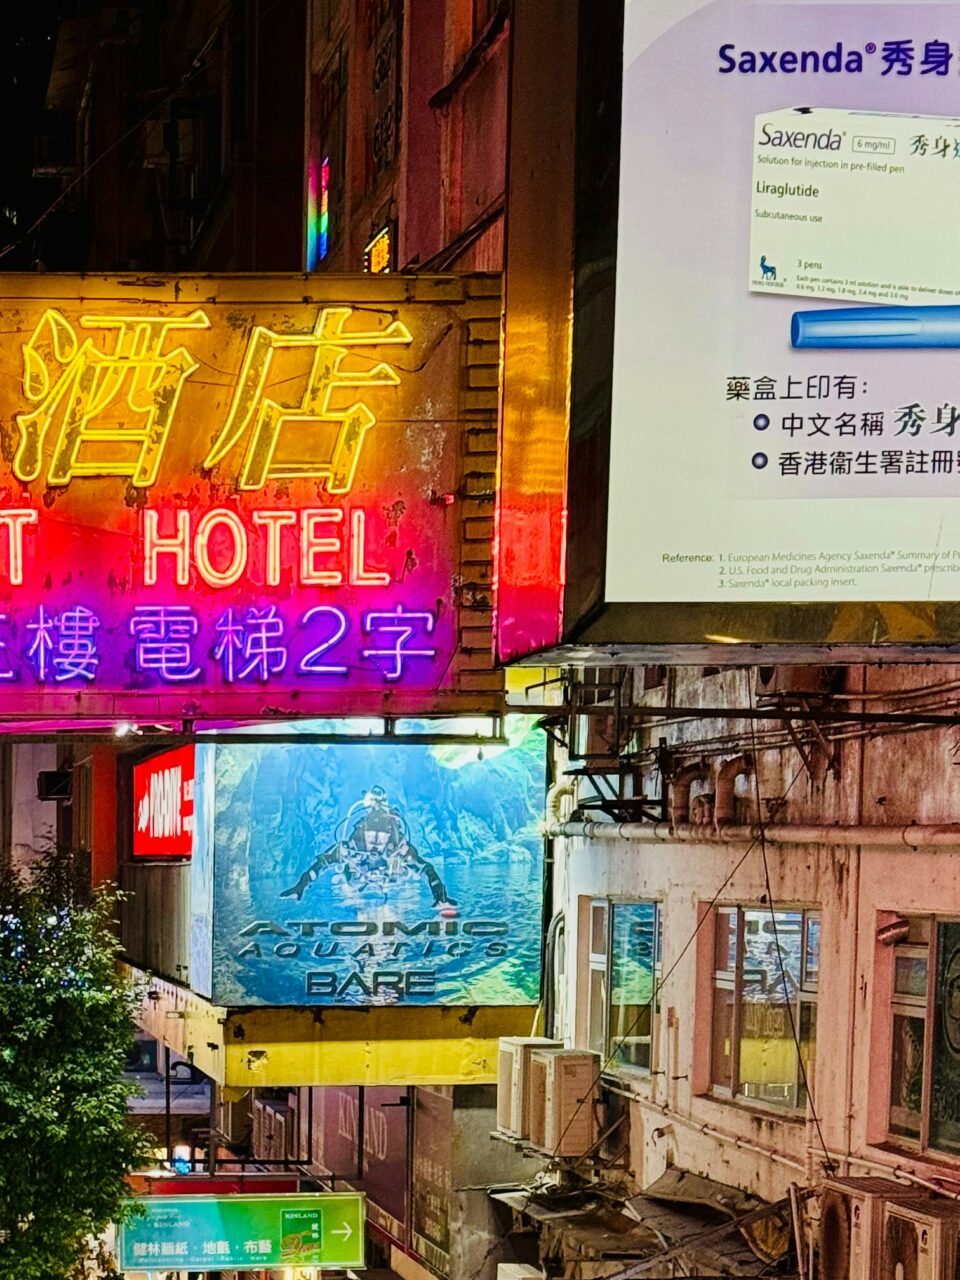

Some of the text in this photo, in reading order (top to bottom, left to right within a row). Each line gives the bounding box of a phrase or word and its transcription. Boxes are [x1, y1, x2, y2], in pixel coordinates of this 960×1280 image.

[857, 140, 863, 149] 6
[757, 154, 789, 166] Solution
[791, 157, 802, 167] for
[840, 160, 849, 169] in
[888, 165, 905, 175] pen
[755, 181, 820, 198] Liraglutide
[755, 208, 823, 223] Subcutaneous use
[797, 259, 823, 270] 3 pens
[13, 306, 413, 495] 酒店
[781, 411, 885, 438] 中文名稱
[778, 449, 960, 476] 香港衞生署註冊
[143, 508, 391, 588] HOTEL
[728, 553, 769, 563] European
[771, 552, 816, 562] Medicines
[818, 552, 852, 562] Agency
[897, 550, 939, 562] Summary
[746, 566, 769, 575] Food
[771, 565, 788, 574] and
[791, 565, 812, 575] Drug
[814, 564, 879, 574] Administration
[771, 578, 791, 587] local
[794, 577, 829, 588] packing
[129, 604, 436, 682] 電梯2字
[239, 920, 509, 937] ATOMIC
[238, 941, 509, 958] AQUATICS
[305, 969, 437, 996] BARE
